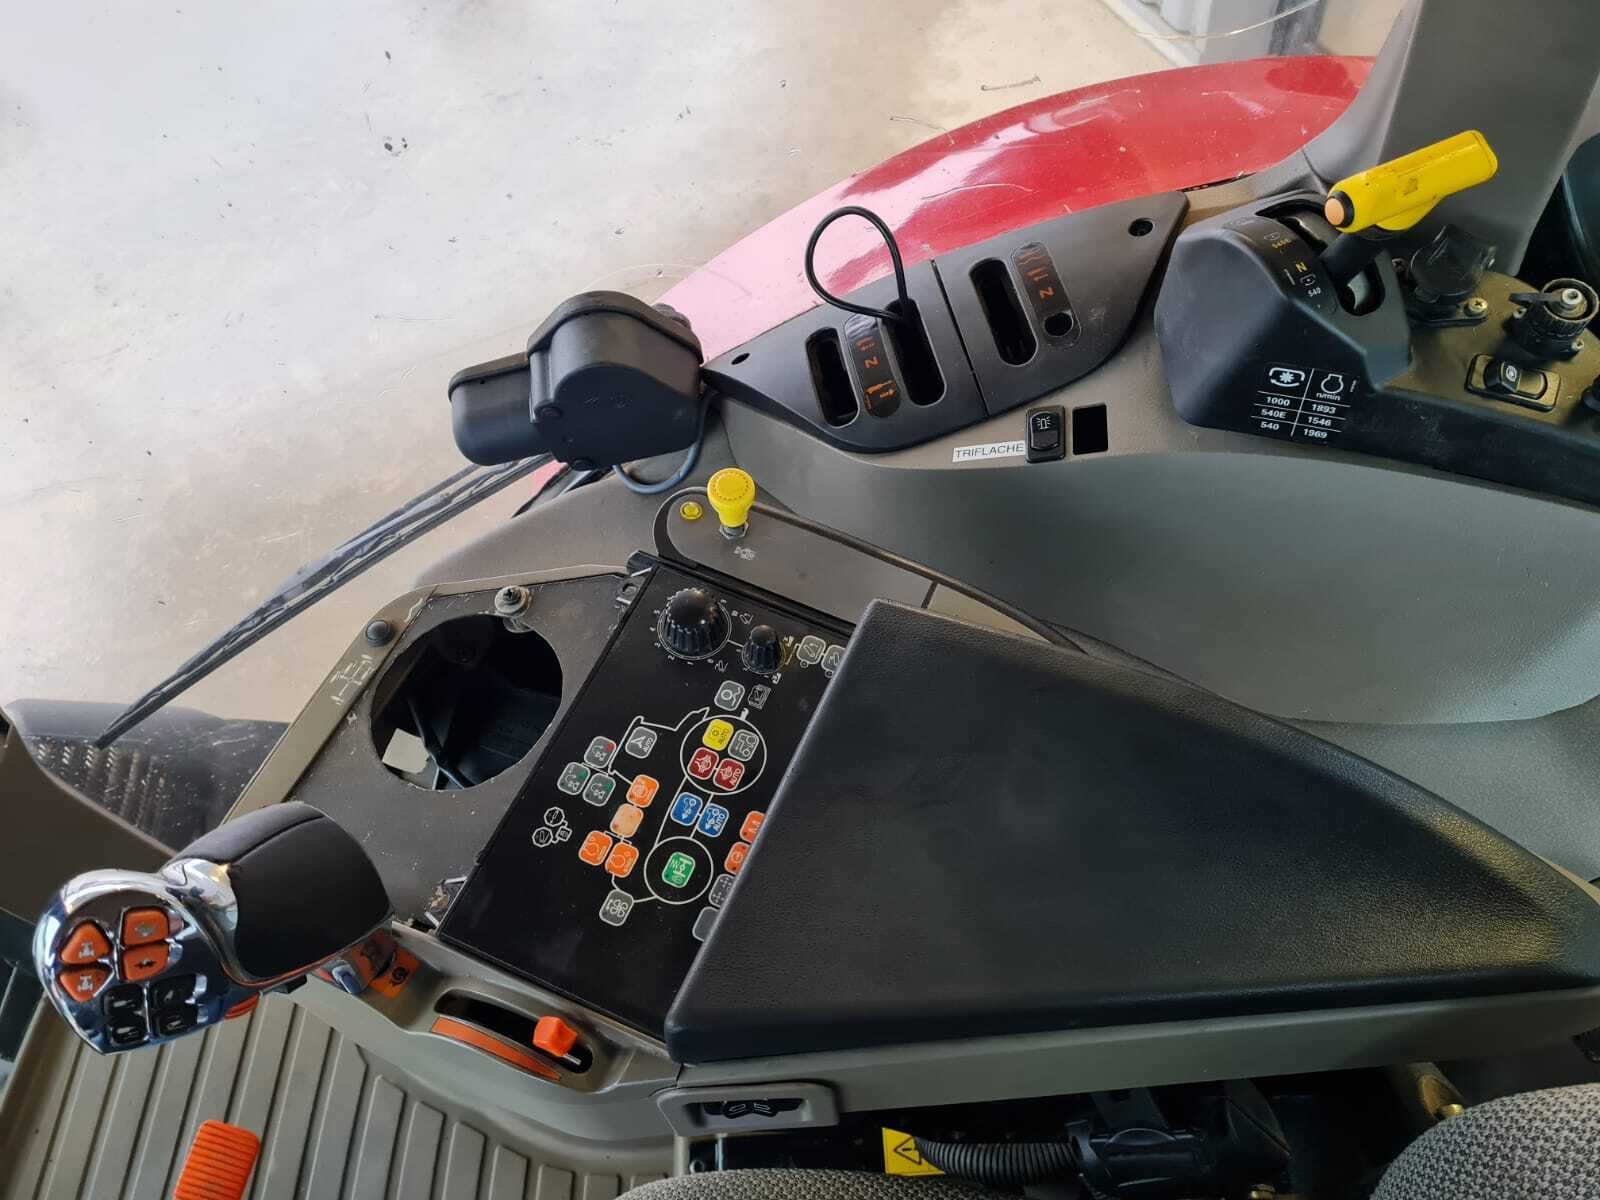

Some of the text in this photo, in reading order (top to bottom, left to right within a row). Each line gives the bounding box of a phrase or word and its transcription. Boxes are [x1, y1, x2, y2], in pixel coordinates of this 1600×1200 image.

[1295, 261, 1308, 273] N
[1266, 396, 1336, 414] 1000 1893
[1261, 408, 1332, 427] 540E 1546
[1260, 421, 1328, 439] 540 1969
[954, 441, 1025, 459] TRIFLACHE
[729, 767, 742, 786] AUTO
[713, 812, 726, 832] AUTO
